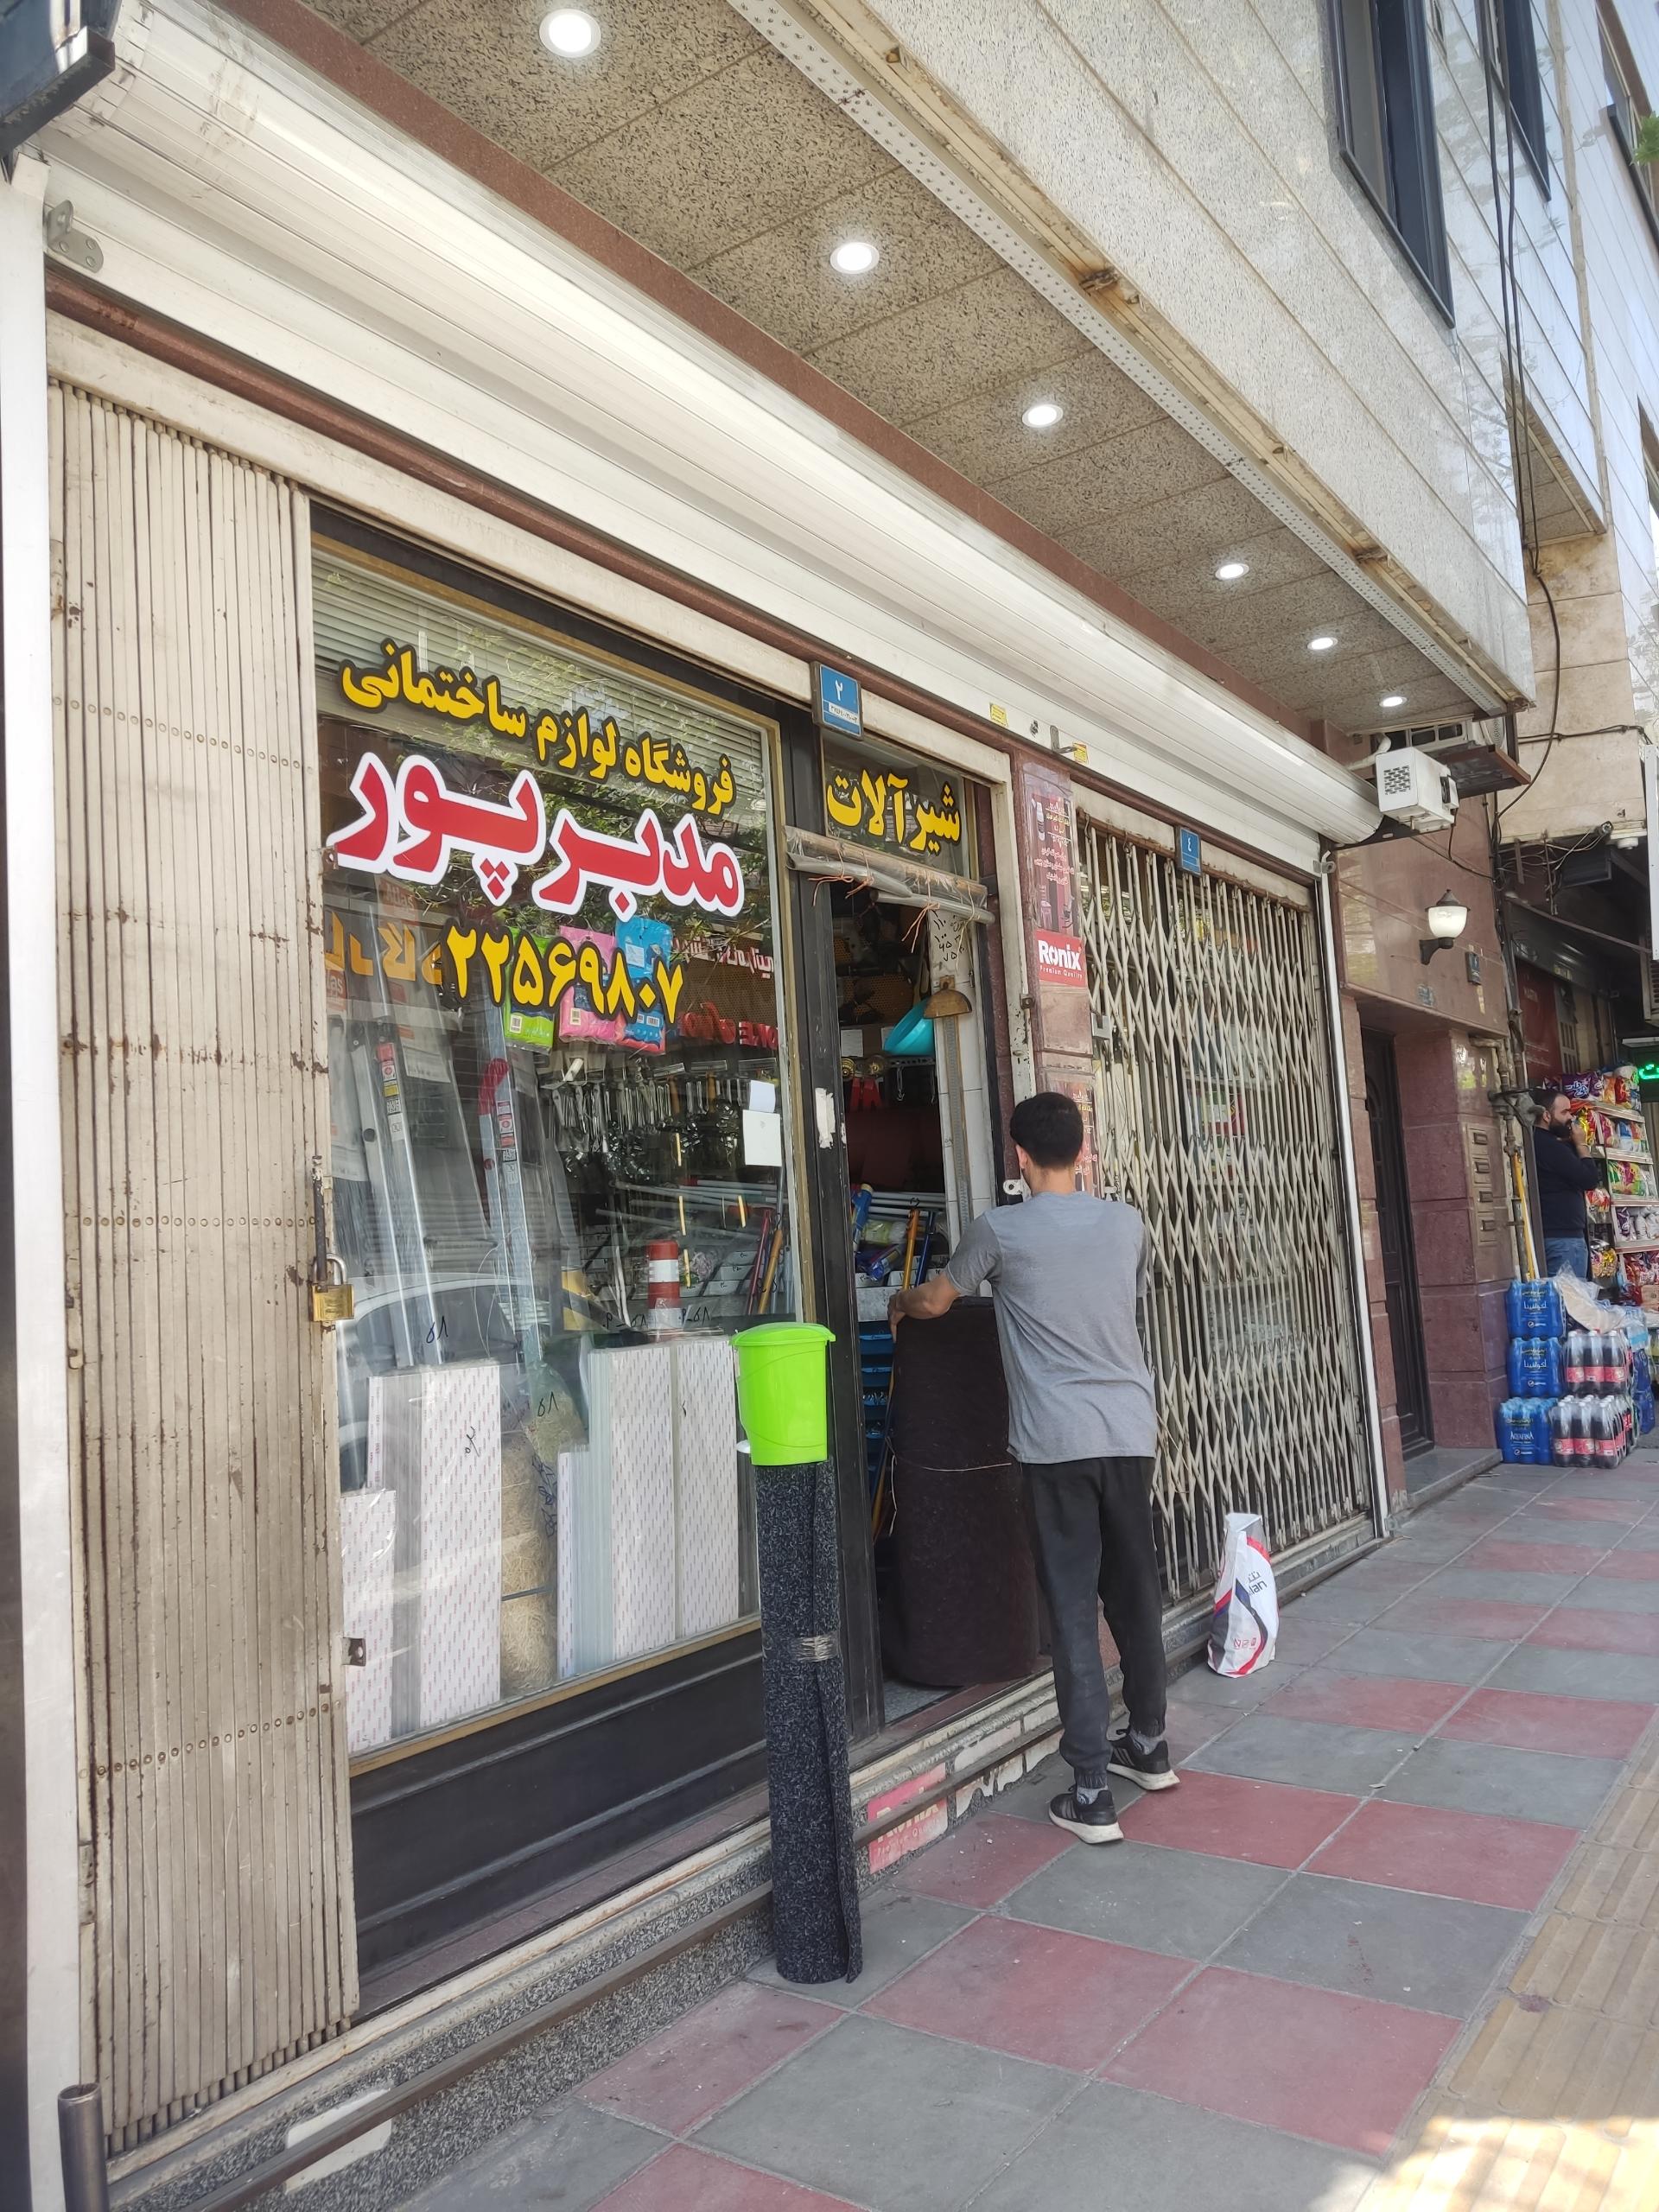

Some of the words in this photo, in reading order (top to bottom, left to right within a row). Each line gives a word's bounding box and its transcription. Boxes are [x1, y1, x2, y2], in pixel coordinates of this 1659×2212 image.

[342, 643, 527, 739] ساختمانی
[835, 679, 843, 701] ۲
[536, 715, 618, 779] لوازم
[625, 735, 734, 815] فروشگاه
[446, 925, 684, 1021] ۲۲۵۶۹۸۰۷
[1038, 939, 1082, 971] Ronix
